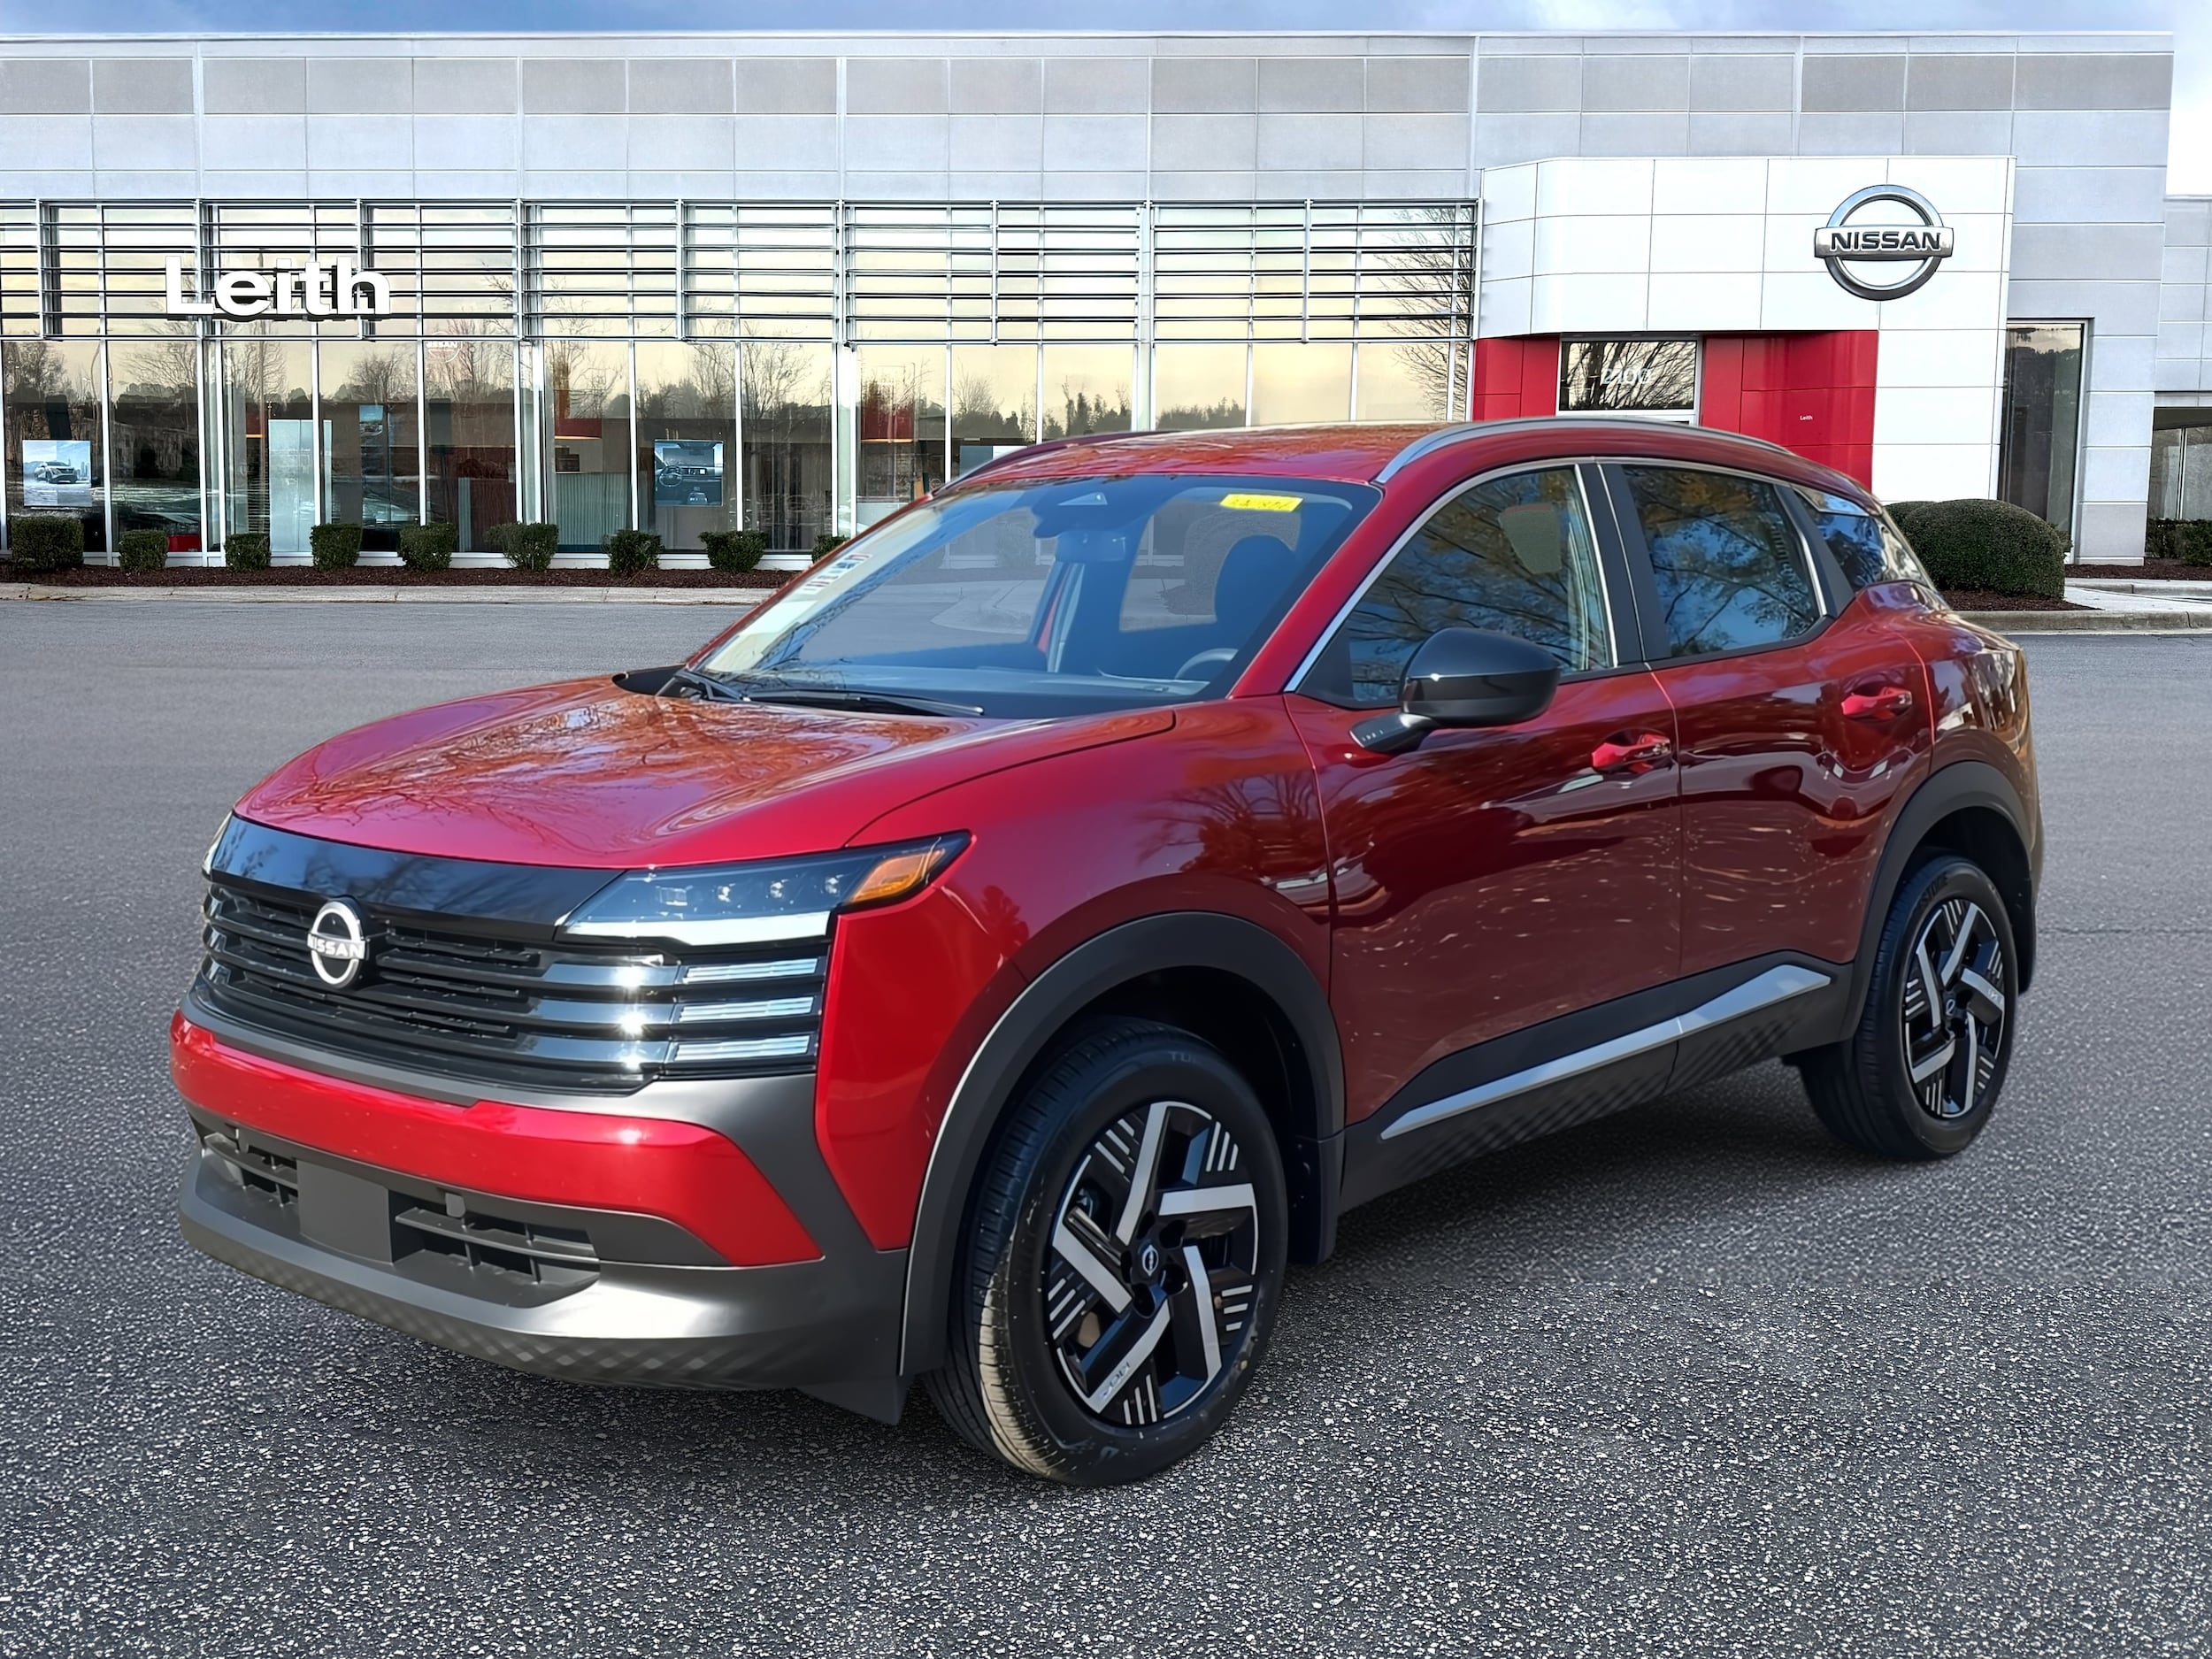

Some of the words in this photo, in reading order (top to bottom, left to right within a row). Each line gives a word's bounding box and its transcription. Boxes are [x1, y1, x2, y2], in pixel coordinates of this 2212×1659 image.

[1831, 231, 1941, 250] NISSAN
[165, 256, 390, 316] Leith
[1602, 368, 1651, 384] 2100
[308, 934, 362, 958] NISSAN
